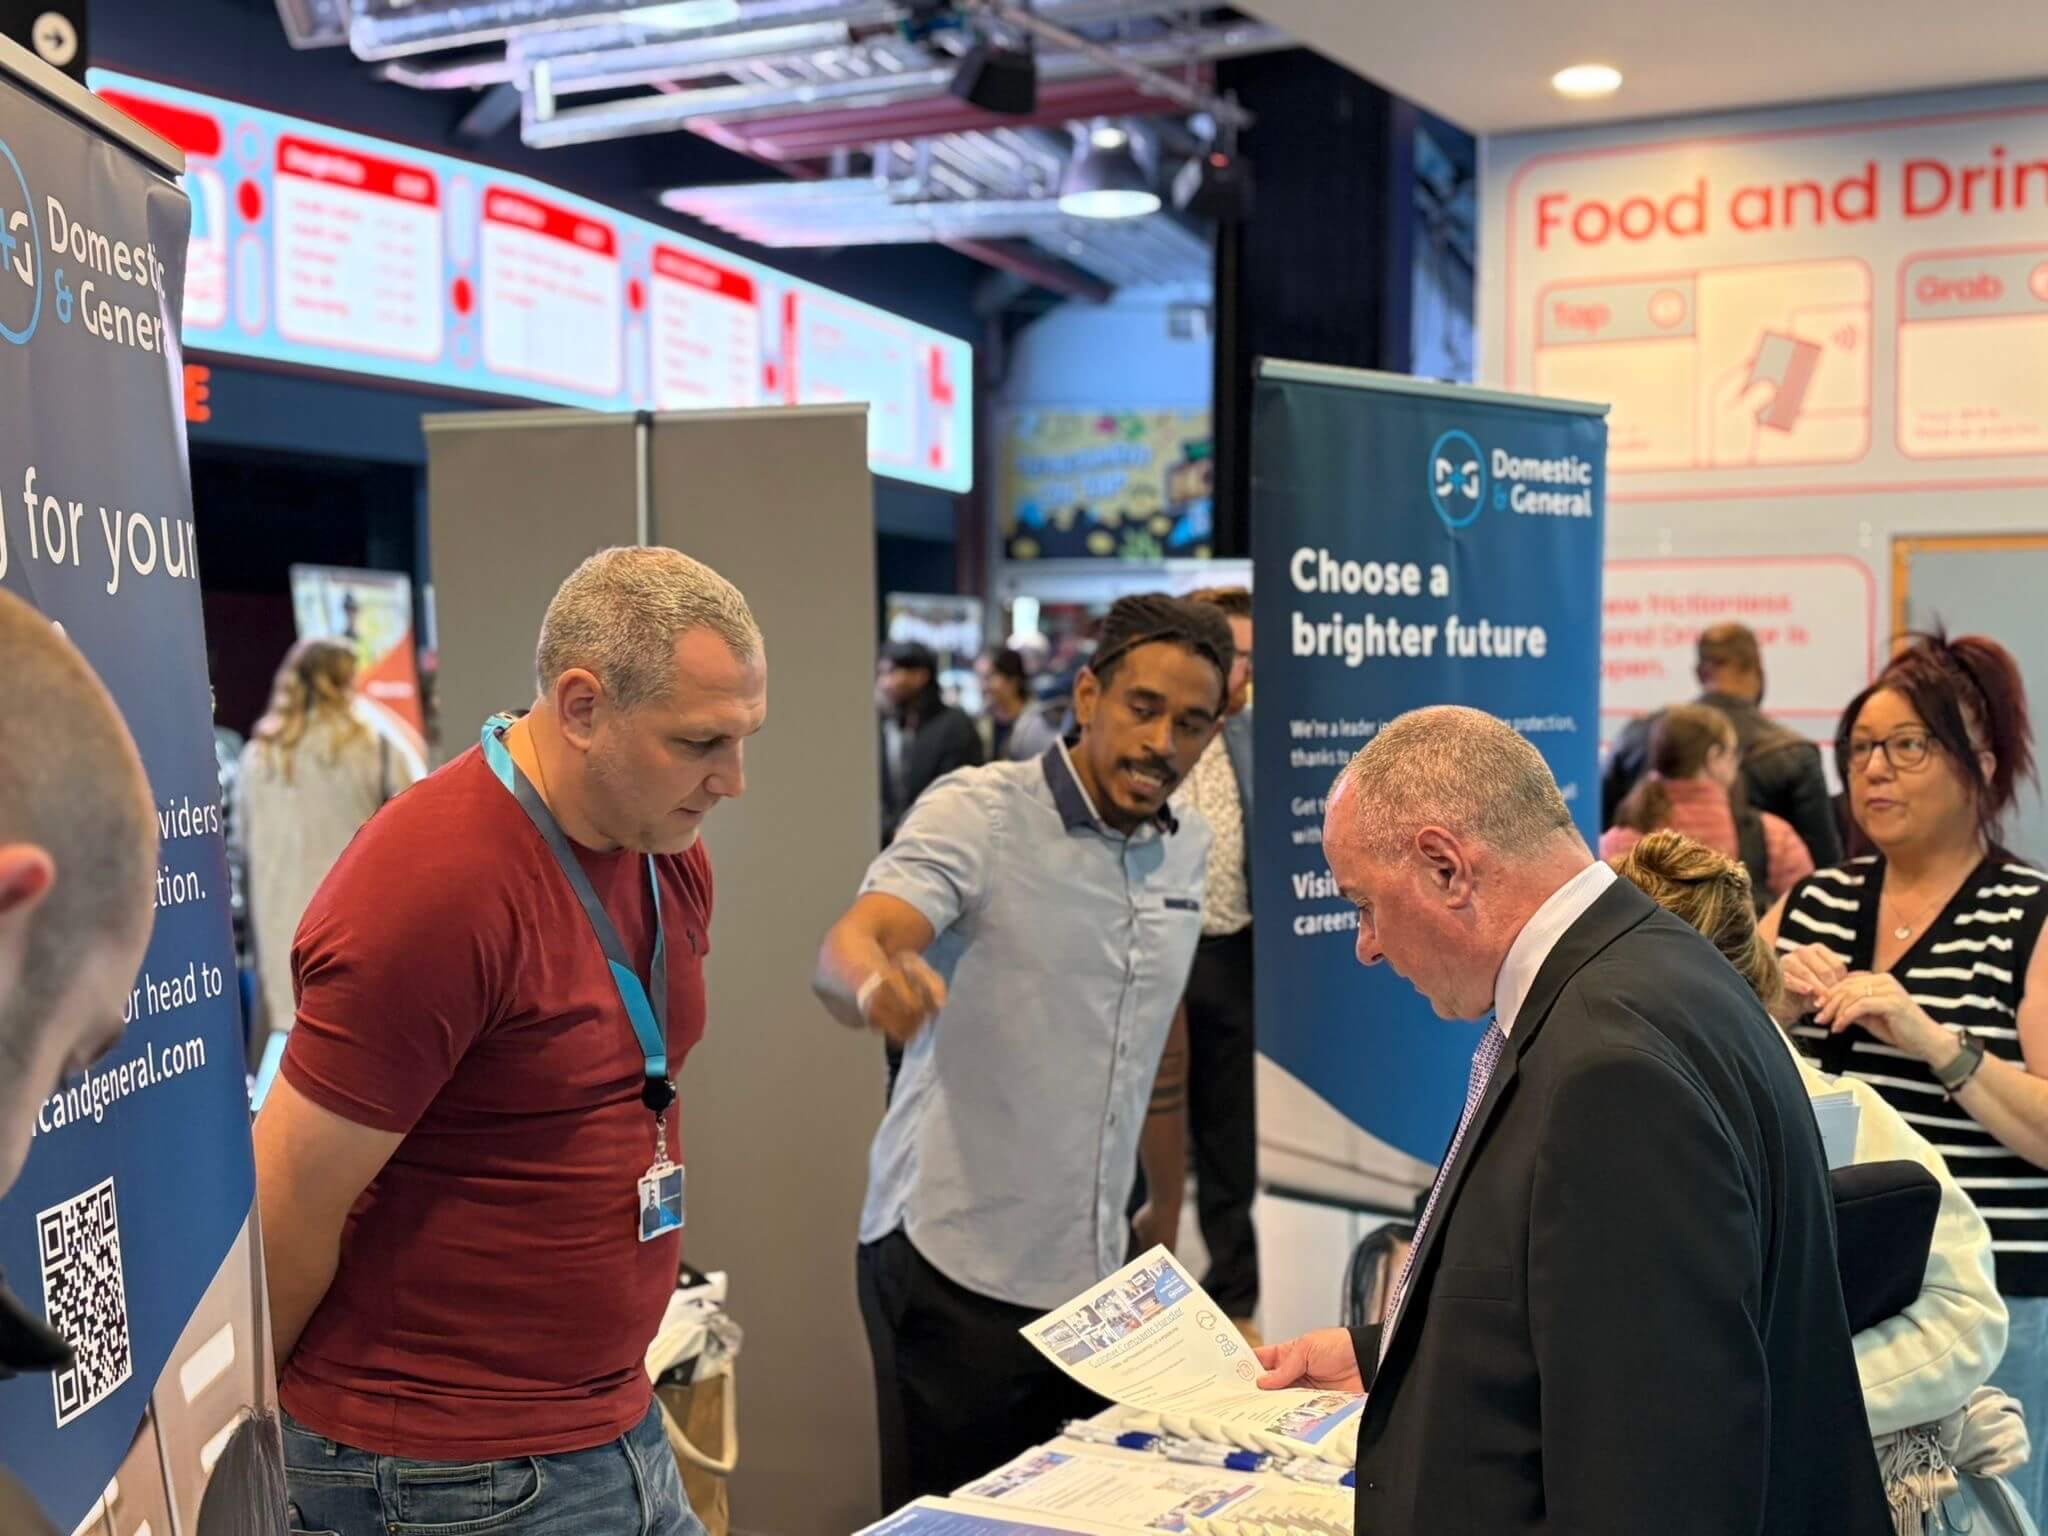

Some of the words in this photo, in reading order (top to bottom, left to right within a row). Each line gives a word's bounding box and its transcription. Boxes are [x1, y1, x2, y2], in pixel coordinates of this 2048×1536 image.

[1535, 178, 1707, 250] Food
[1729, 161, 1878, 231] and
[1902, 145, 2048, 219] Drin
[47, 195, 166, 300] Domestic
[55, 268, 74, 324] &
[80, 280, 169, 359] Gener
[1915, 273, 2003, 305] Grab
[184, 364, 211, 422] E
[1491, 448, 1593, 485] Domestic
[1492, 484, 1507, 512] &
[1510, 484, 1593, 517] General
[24, 466, 84, 565] for
[99, 506, 196, 595] your
[1290, 547, 1421, 596] Choose
[1429, 563, 1449, 597] a
[1291, 611, 1437, 667] brighter
[1445, 614, 1548, 658] future
[1290, 718, 1328, 739] We're
[1330, 721, 1339, 738] a
[1339, 717, 1376, 738] leader
[1291, 748, 1336, 768] thanks
[158, 795, 218, 840] viders
[153, 865, 206, 908] tion.
[145, 961, 197, 1016] head
[202, 961, 222, 999] to
[31, 1036, 206, 1138] candgeneral.com
